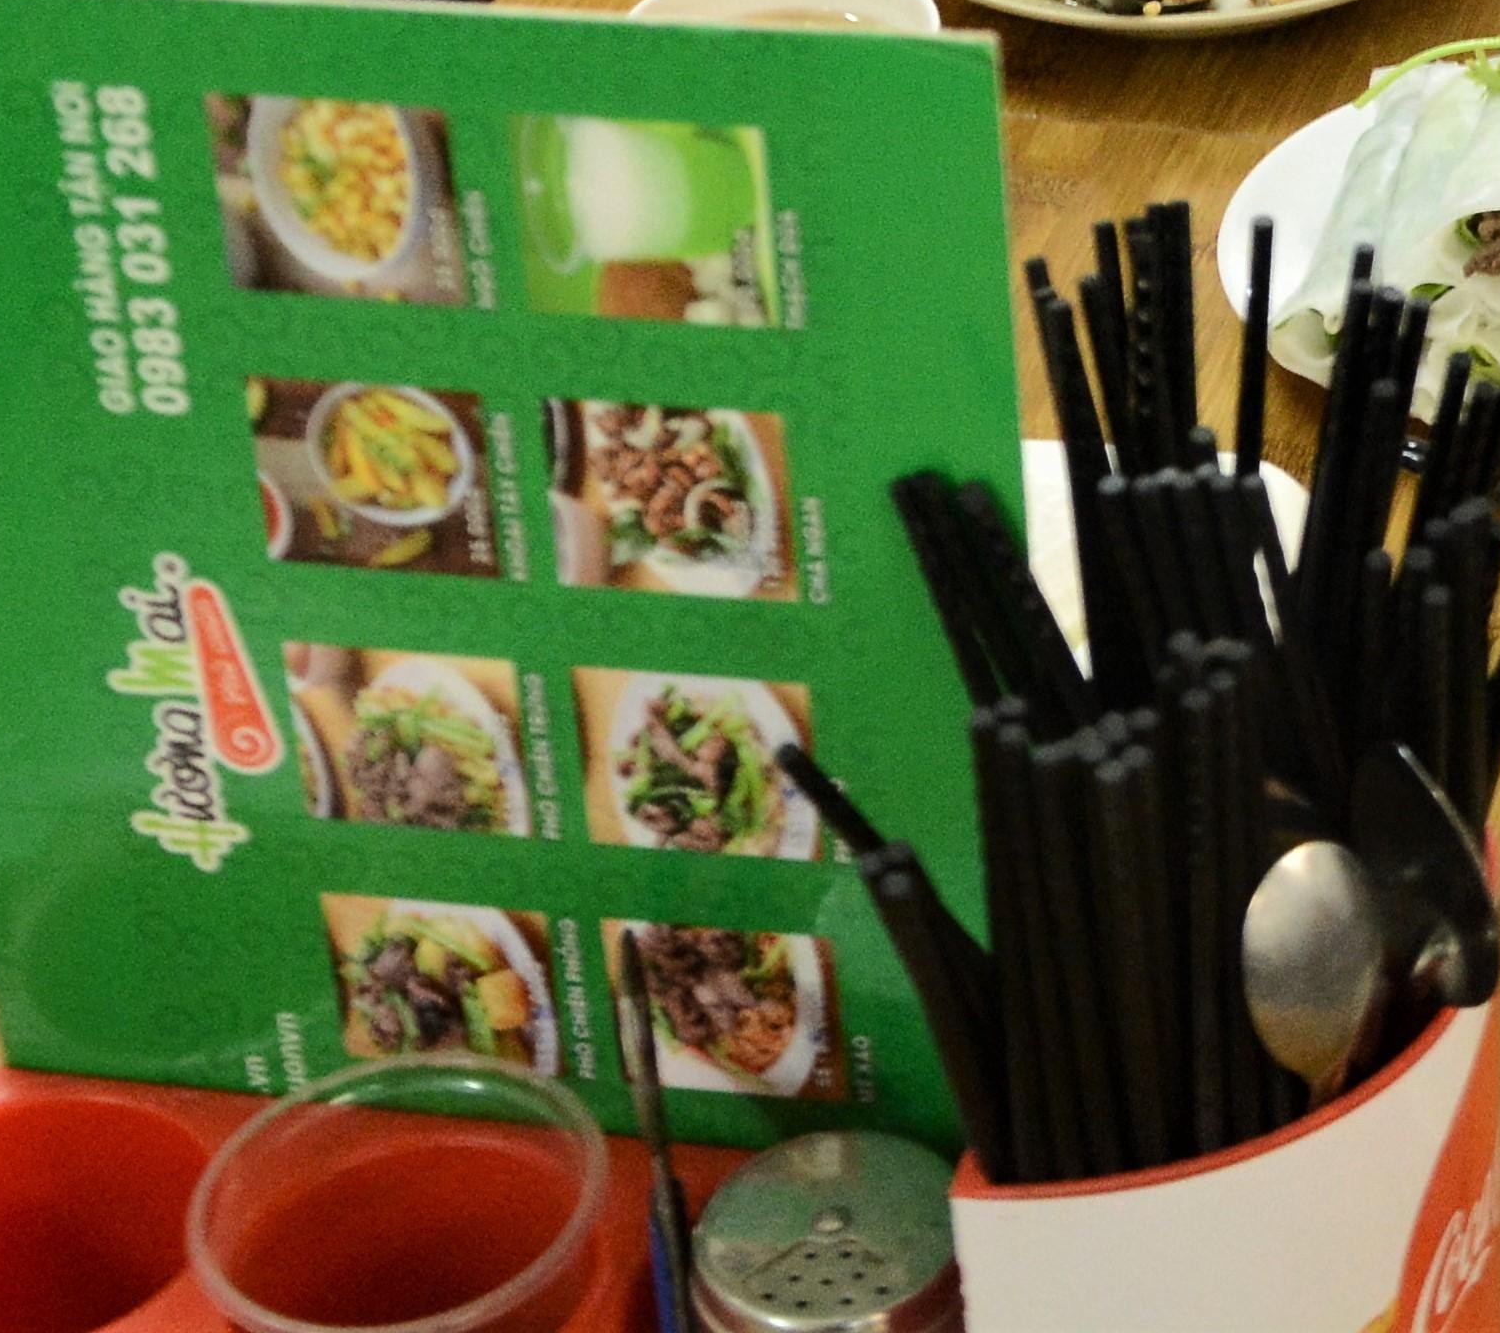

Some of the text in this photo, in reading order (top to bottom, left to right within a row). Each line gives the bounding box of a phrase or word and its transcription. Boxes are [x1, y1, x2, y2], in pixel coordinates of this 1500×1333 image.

[97, 85, 192, 416] 0983 031 268
[89, 328, 136, 415] GIAO
